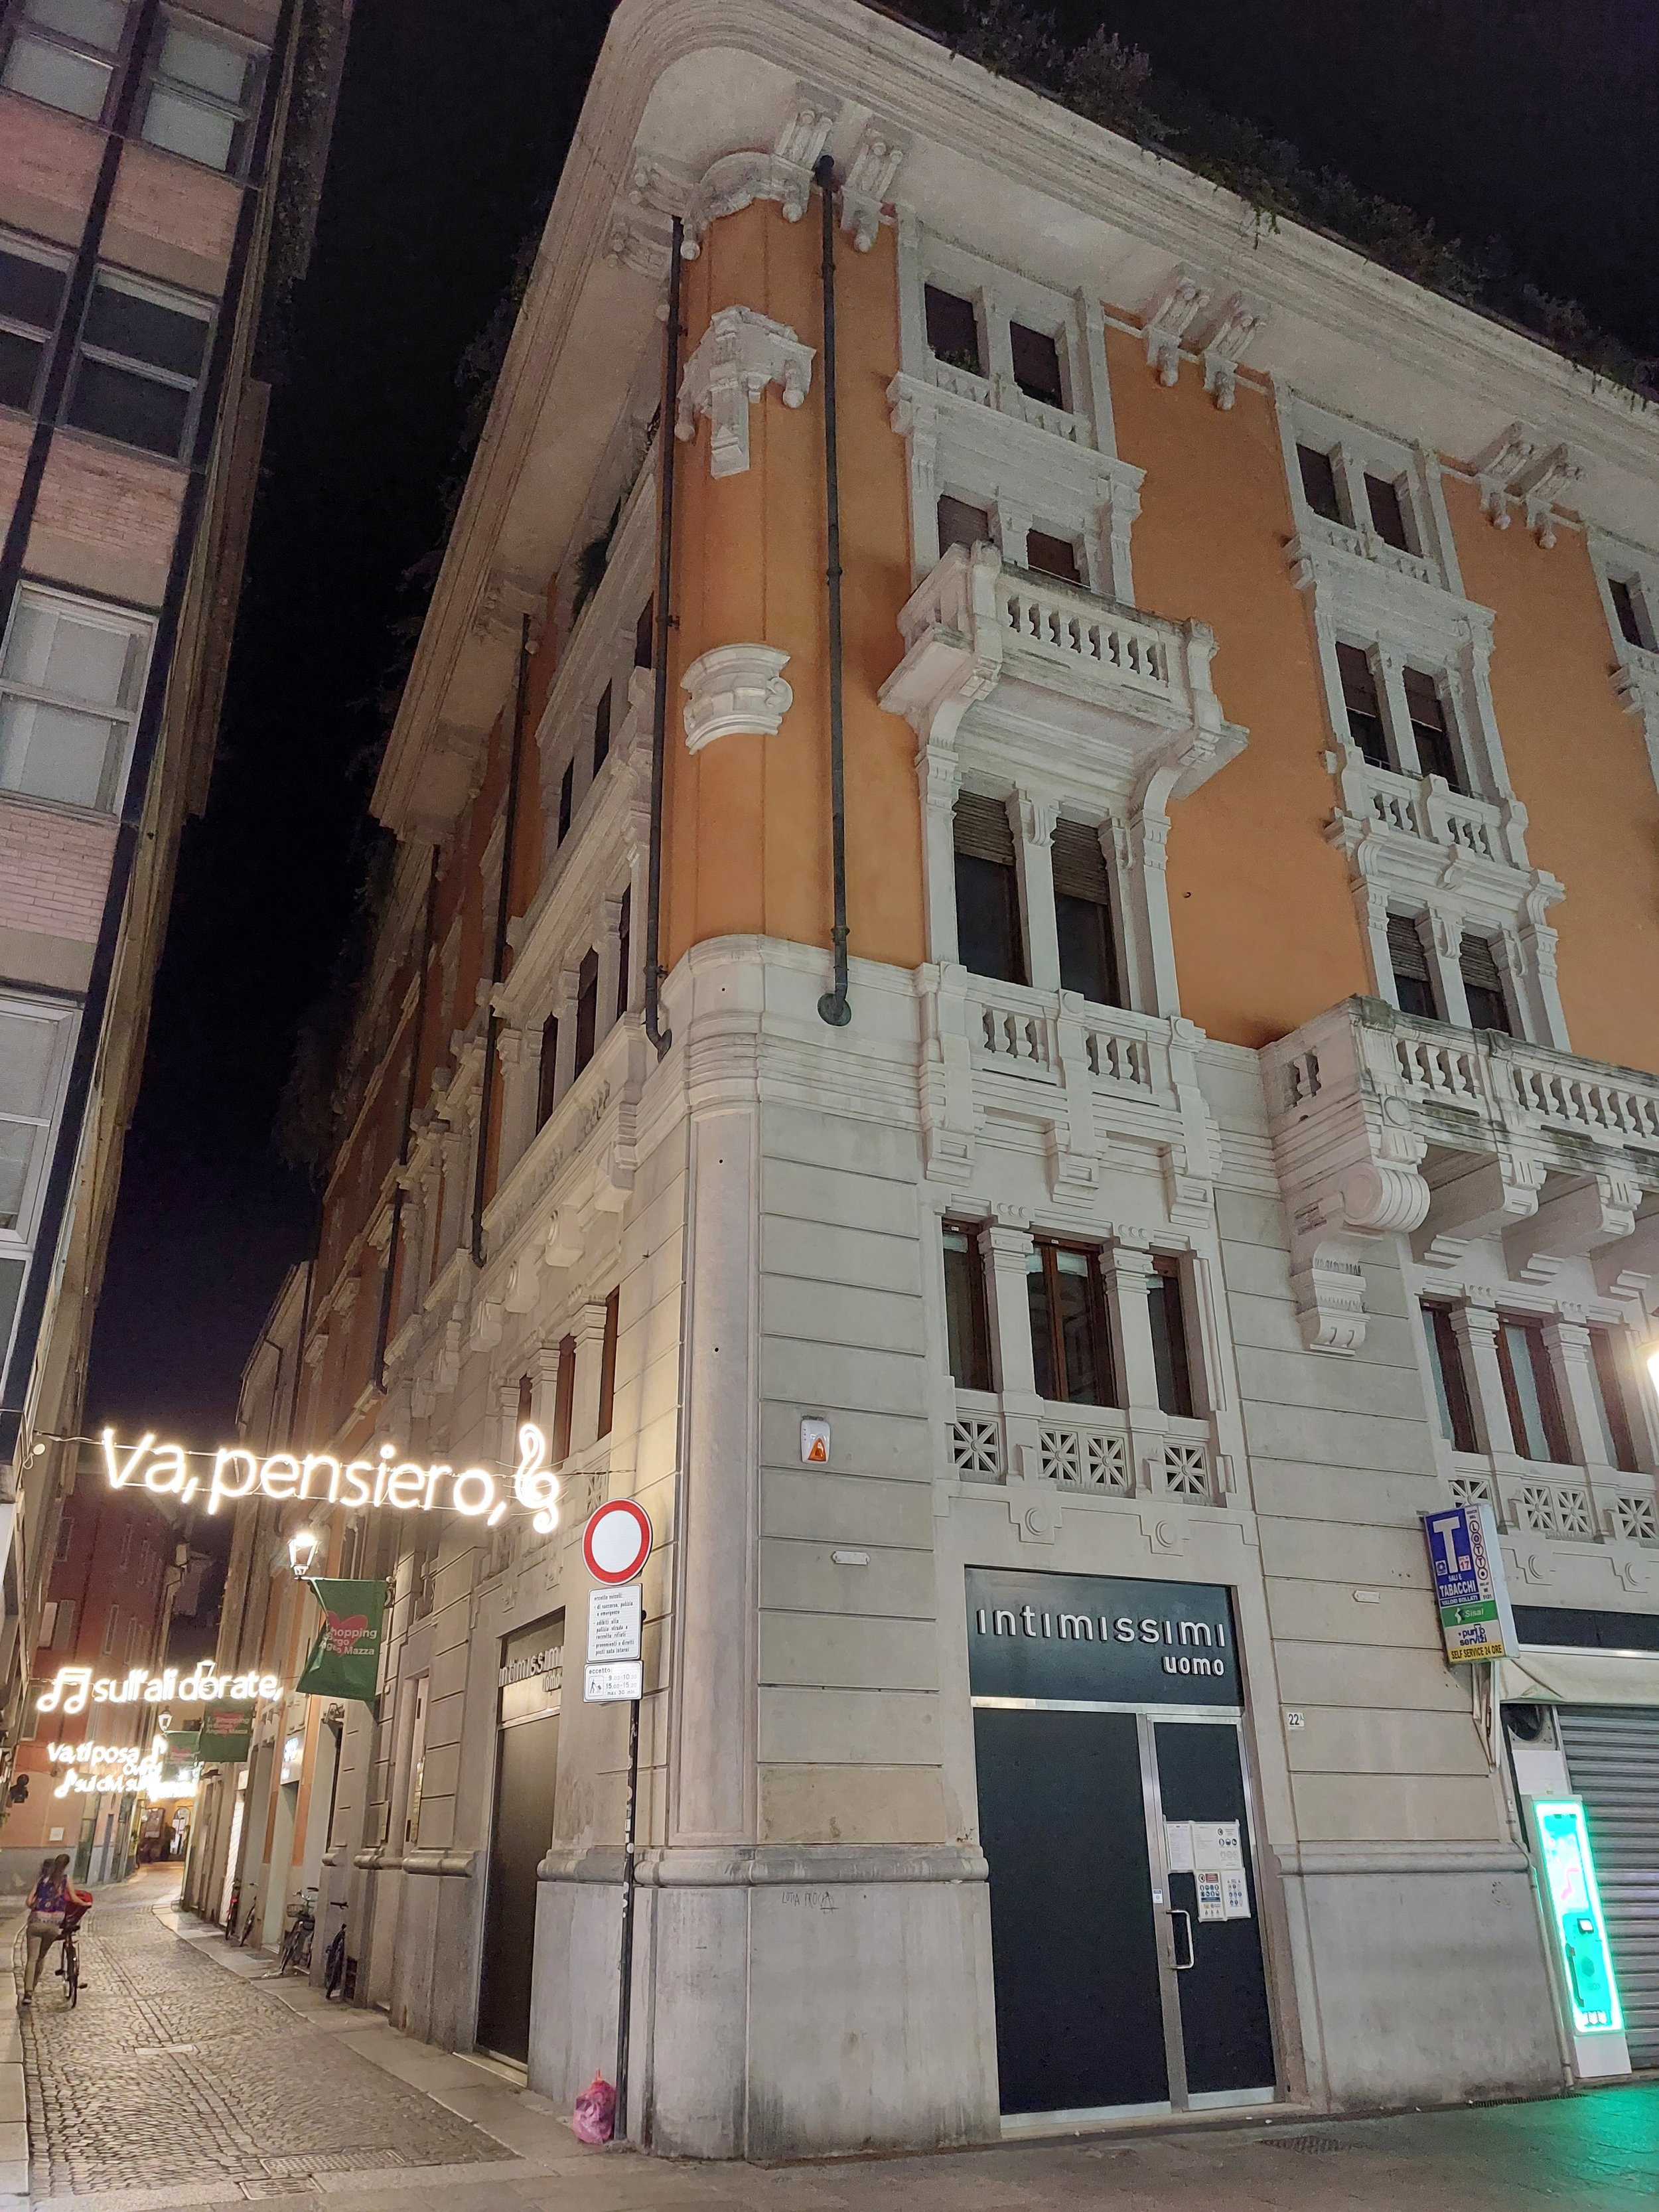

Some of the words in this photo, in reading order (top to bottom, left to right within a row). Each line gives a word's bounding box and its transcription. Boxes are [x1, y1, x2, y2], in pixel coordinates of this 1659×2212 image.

[102, 1428, 198, 1505] Va,
[208, 1442, 507, 1526] pensiero,
[1432, 1515, 1461, 1574] T
[1460, 1560, 1469, 1570] 17
[1439, 1580, 1477, 1597] TABACCHI
[1465, 1607, 1484, 1618] Sisal
[976, 1605, 1226, 1647] intimissimi
[1459, 1634, 1488, 1647] servizi
[344, 1646, 375, 1655] Mazza
[1451, 1649, 1464, 1660] SELF
[1463, 1647, 1484, 1659] SERVICE
[1484, 1646, 1491, 1655] 24
[1491, 1645, 1502, 1655] ORE
[1163, 1655, 1224, 1676] uomo
